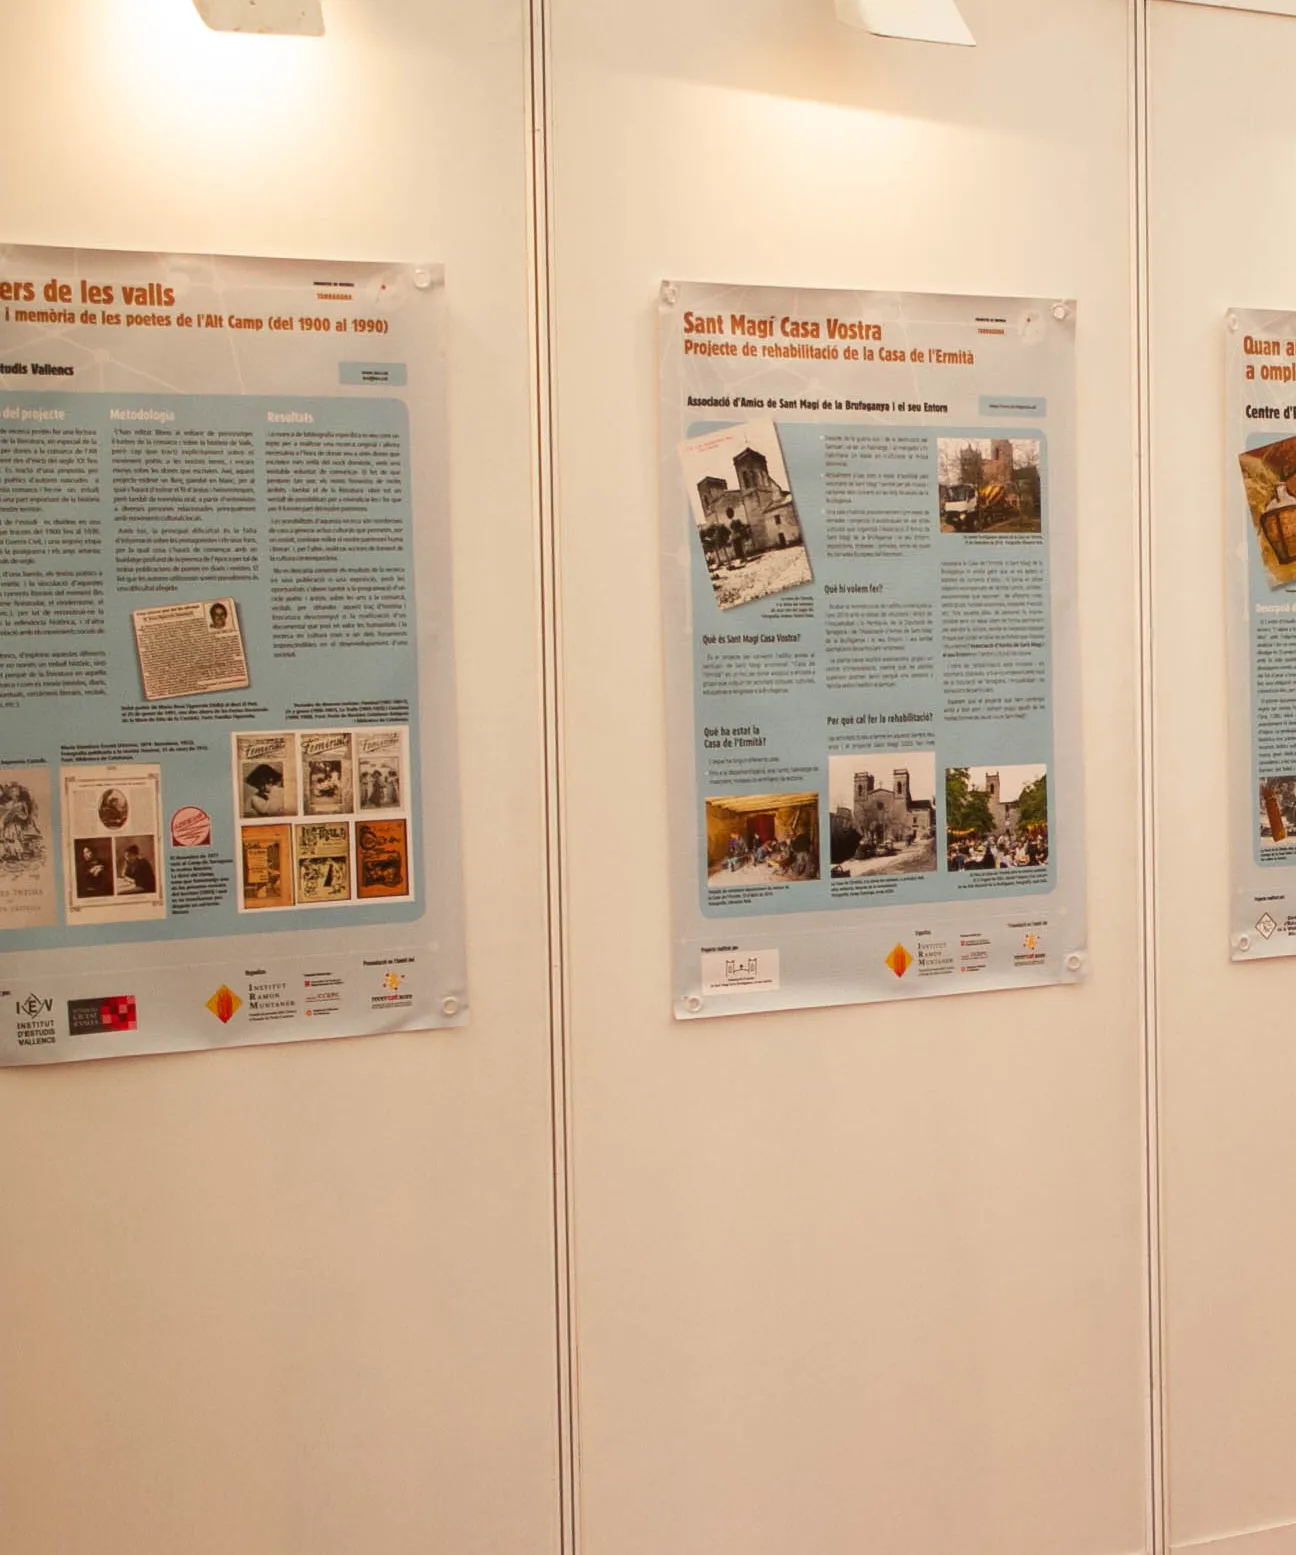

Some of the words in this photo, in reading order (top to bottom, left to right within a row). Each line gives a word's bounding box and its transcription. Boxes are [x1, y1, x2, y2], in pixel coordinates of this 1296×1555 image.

[44, 279, 72, 303] de
[81, 280, 114, 304] les
[122, 283, 175, 306] valls
[5, 307, 9, 321] i
[15, 309, 75, 323] memòria
[80, 310, 96, 324] de
[102, 311, 121, 325] les
[126, 313, 172, 327] poetes
[176, 314, 192, 327] de
[197, 314, 223, 328] l'Alt
[228, 315, 263, 330] Camp
[268, 317, 293, 330] (del
[298, 318, 330, 331] 1900
[336, 319, 347, 332] al
[352, 319, 388, 334] 1990)
[684, 312, 723, 334] Sant
[731, 314, 776, 338] Magí
[781, 316, 820, 338] Casa
[826, 318, 881, 341] Vostra
[684, 339, 737, 356] Projecte
[742, 342, 757, 356] de
[762, 343, 838, 360] rehabilitació
[843, 346, 858, 360] de
[863, 346, 874, 361] la
[879, 347, 905, 362] Casa
[910, 349, 924, 362] de
[929, 349, 974, 364] l'Ermità
[1244, 336, 1280, 355] Quan
[31, 363, 74, 375] Vallencs
[1246, 365, 1254, 379] a
[688, 396, 730, 407] Associació
[733, 397, 764, 408] d'Amics
[767, 399, 777, 408] de
[779, 399, 797, 408] Sant
[800, 400, 819, 410] Magí
[822, 400, 832, 409] de
[835, 400, 842, 410] la
[846, 400, 889, 412] Brufaganya
[893, 402, 895, 411] i
[898, 402, 905, 411] el
[908, 404, 921, 412] seu
[924, 403, 947, 412] Entorn
[3, 407, 20, 419] del
[21, 409, 65, 421] projecte
[110, 409, 174, 423] Metodologia
[267, 411, 313, 422] Resultats
[1246, 405, 1280, 419] Centre
[824, 585, 838, 594] Què
[839, 584, 846, 593] hi
[847, 584, 868, 593] volem
[869, 584, 883, 593] fer?
[703, 635, 716, 645] Què
[727, 635, 744, 643] Sant
[743, 634, 758, 645] Magí
[761, 634, 775, 642] Casa
[776, 634, 800, 642] Vostra?
[827, 717, 838, 725] Per
[841, 716, 854, 726] què
[856, 715, 866, 724] cal
[868, 714, 877, 724] fer
[878, 714, 886, 723] la
[888, 713, 933, 722] rehabilitació?
[704, 728, 718, 738] Què
[721, 727, 730, 736] ha
[732, 727, 750, 735] estat
[753, 725, 759, 735] la
[704, 740, 721, 748] Casa
[723, 738, 732, 748] de
[734, 737, 766, 747] l'Ermità?
